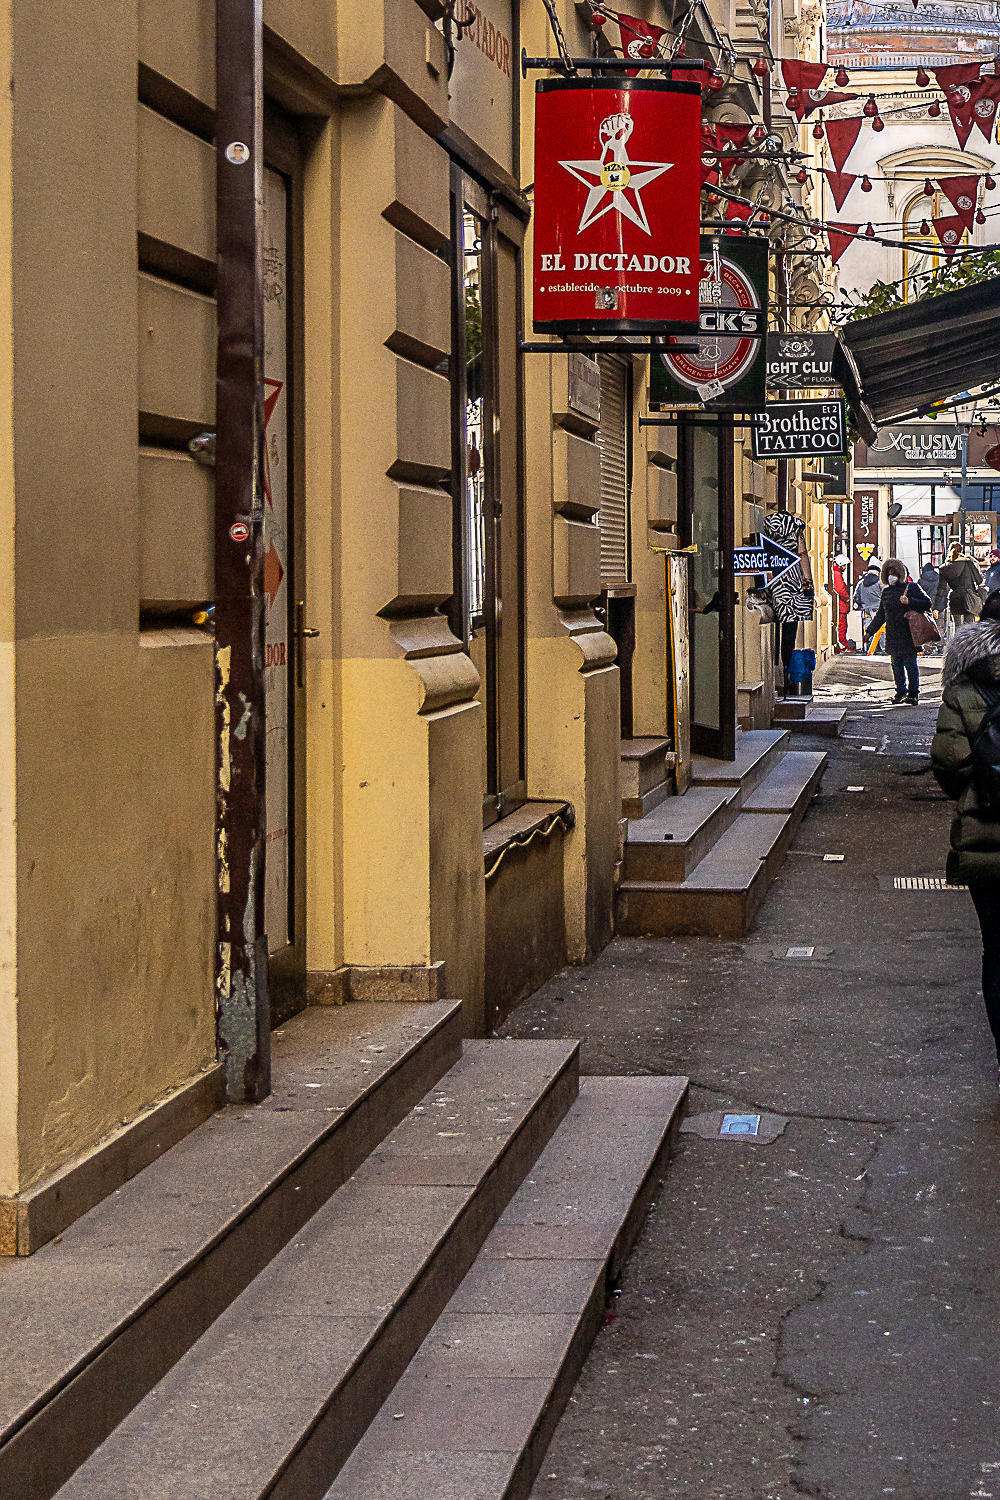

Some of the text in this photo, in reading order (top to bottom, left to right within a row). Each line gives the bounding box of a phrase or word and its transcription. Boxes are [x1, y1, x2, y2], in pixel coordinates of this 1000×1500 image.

[541, 253, 692, 275] EL DICTADOR
[548, 282, 683, 297] establecido octubre 2009
[700, 311, 758, 332] CK'S
[766, 361, 832, 374] IGHT CLU
[822, 405, 838, 414] Et 2
[758, 410, 838, 434] Brothers
[760, 432, 840, 451] TATTOO
[733, 553, 769, 569] ASSAGE
